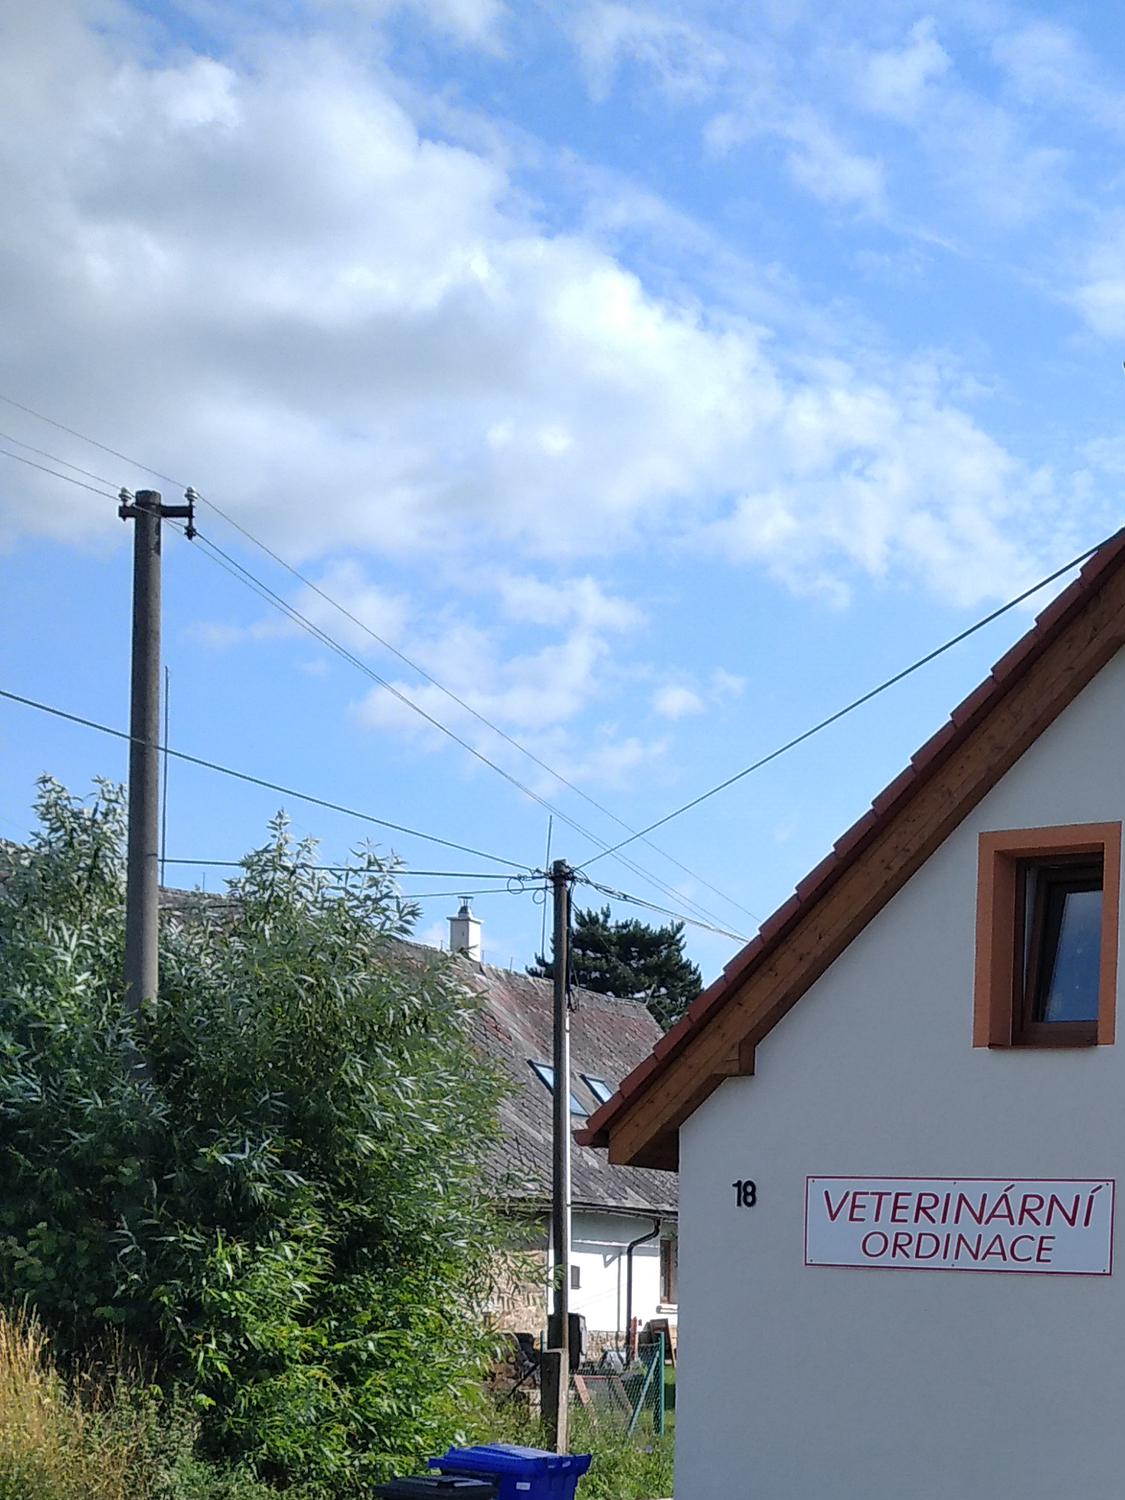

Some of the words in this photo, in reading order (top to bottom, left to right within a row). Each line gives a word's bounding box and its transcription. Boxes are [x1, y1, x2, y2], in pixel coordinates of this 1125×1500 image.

[731, 1179, 757, 1208] 18
[823, 1183, 1104, 1228] VETERINÁRNÍ
[860, 1230, 1057, 1263] ORDINACE
